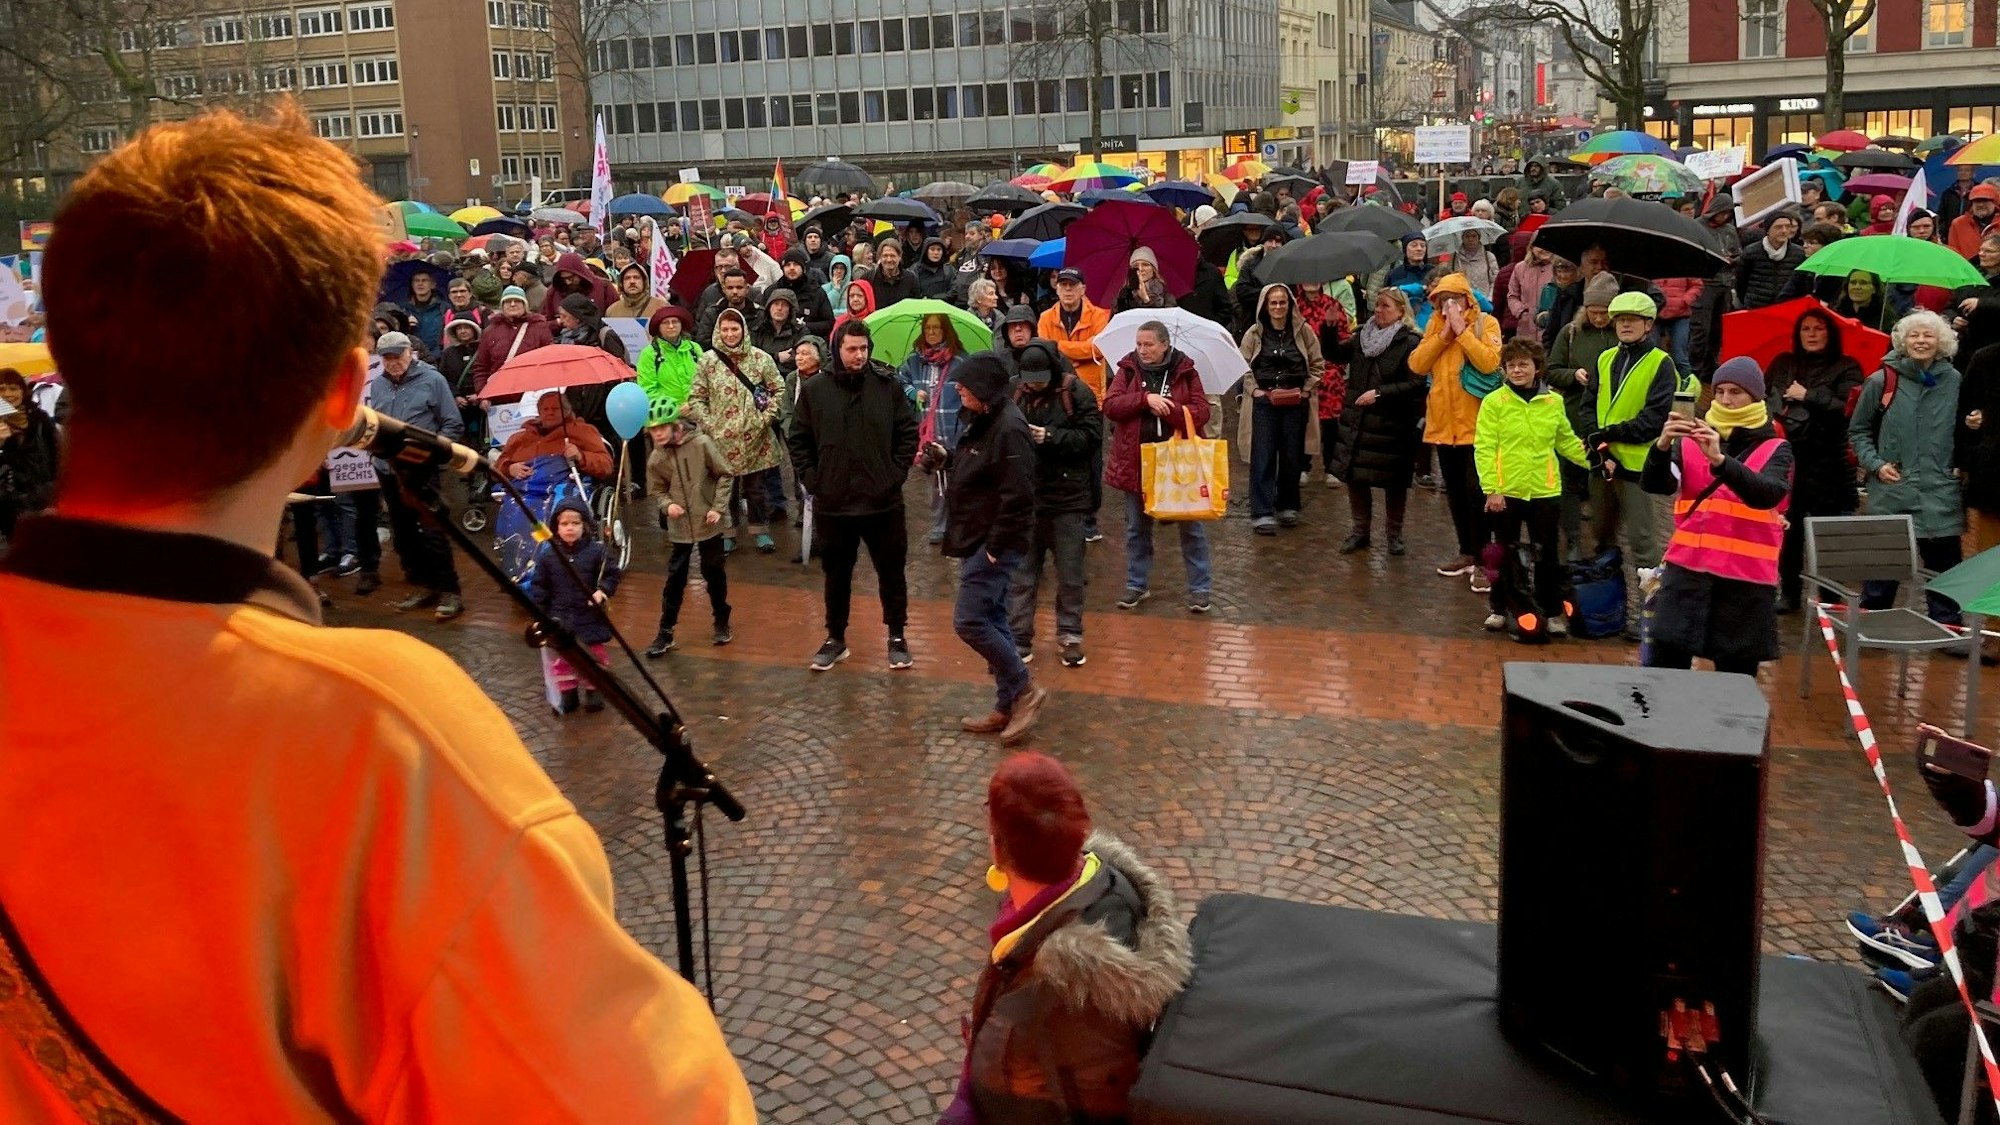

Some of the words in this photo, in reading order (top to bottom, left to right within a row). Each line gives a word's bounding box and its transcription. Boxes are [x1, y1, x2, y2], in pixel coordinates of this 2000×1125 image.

[1779, 98, 1819, 111] KIND
[1100, 138, 1124, 151] ONITA
[334, 461, 372, 473] gegen
[335, 470, 373, 481] RECHTS
